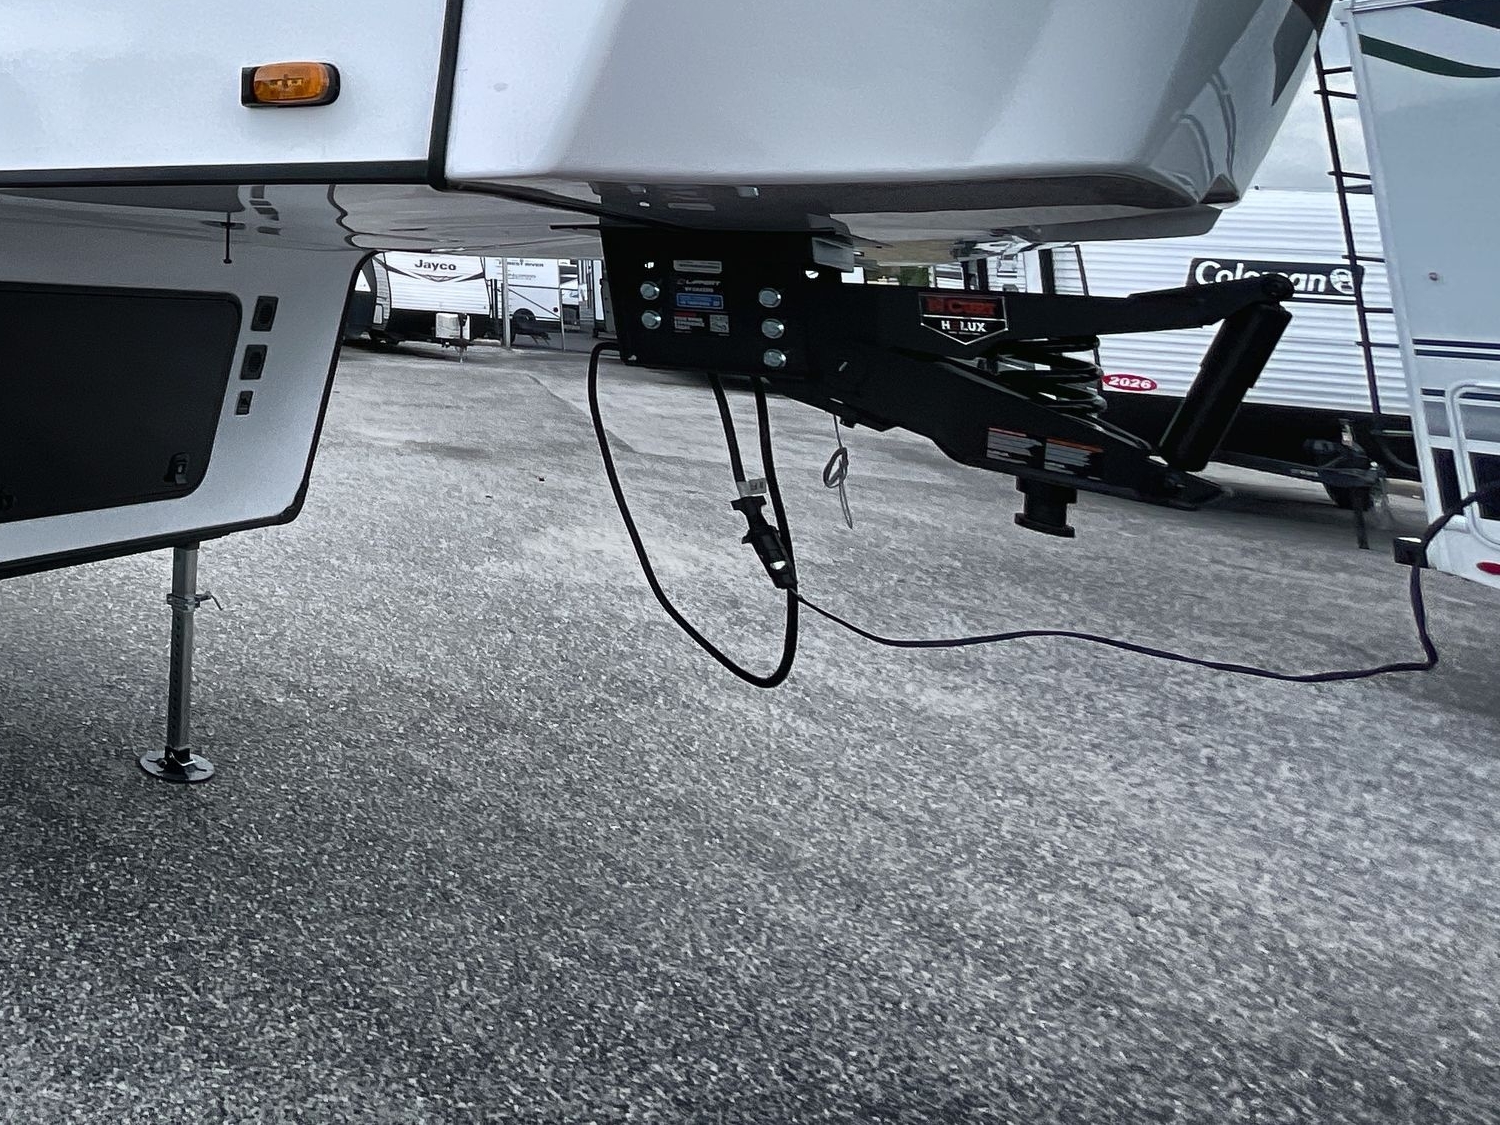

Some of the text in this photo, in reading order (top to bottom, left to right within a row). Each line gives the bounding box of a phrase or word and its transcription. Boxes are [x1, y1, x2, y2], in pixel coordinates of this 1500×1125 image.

[414, 259, 457, 271] Jayco
[1195, 260, 1327, 293] Colan
[1109, 376, 1152, 389] 2026
